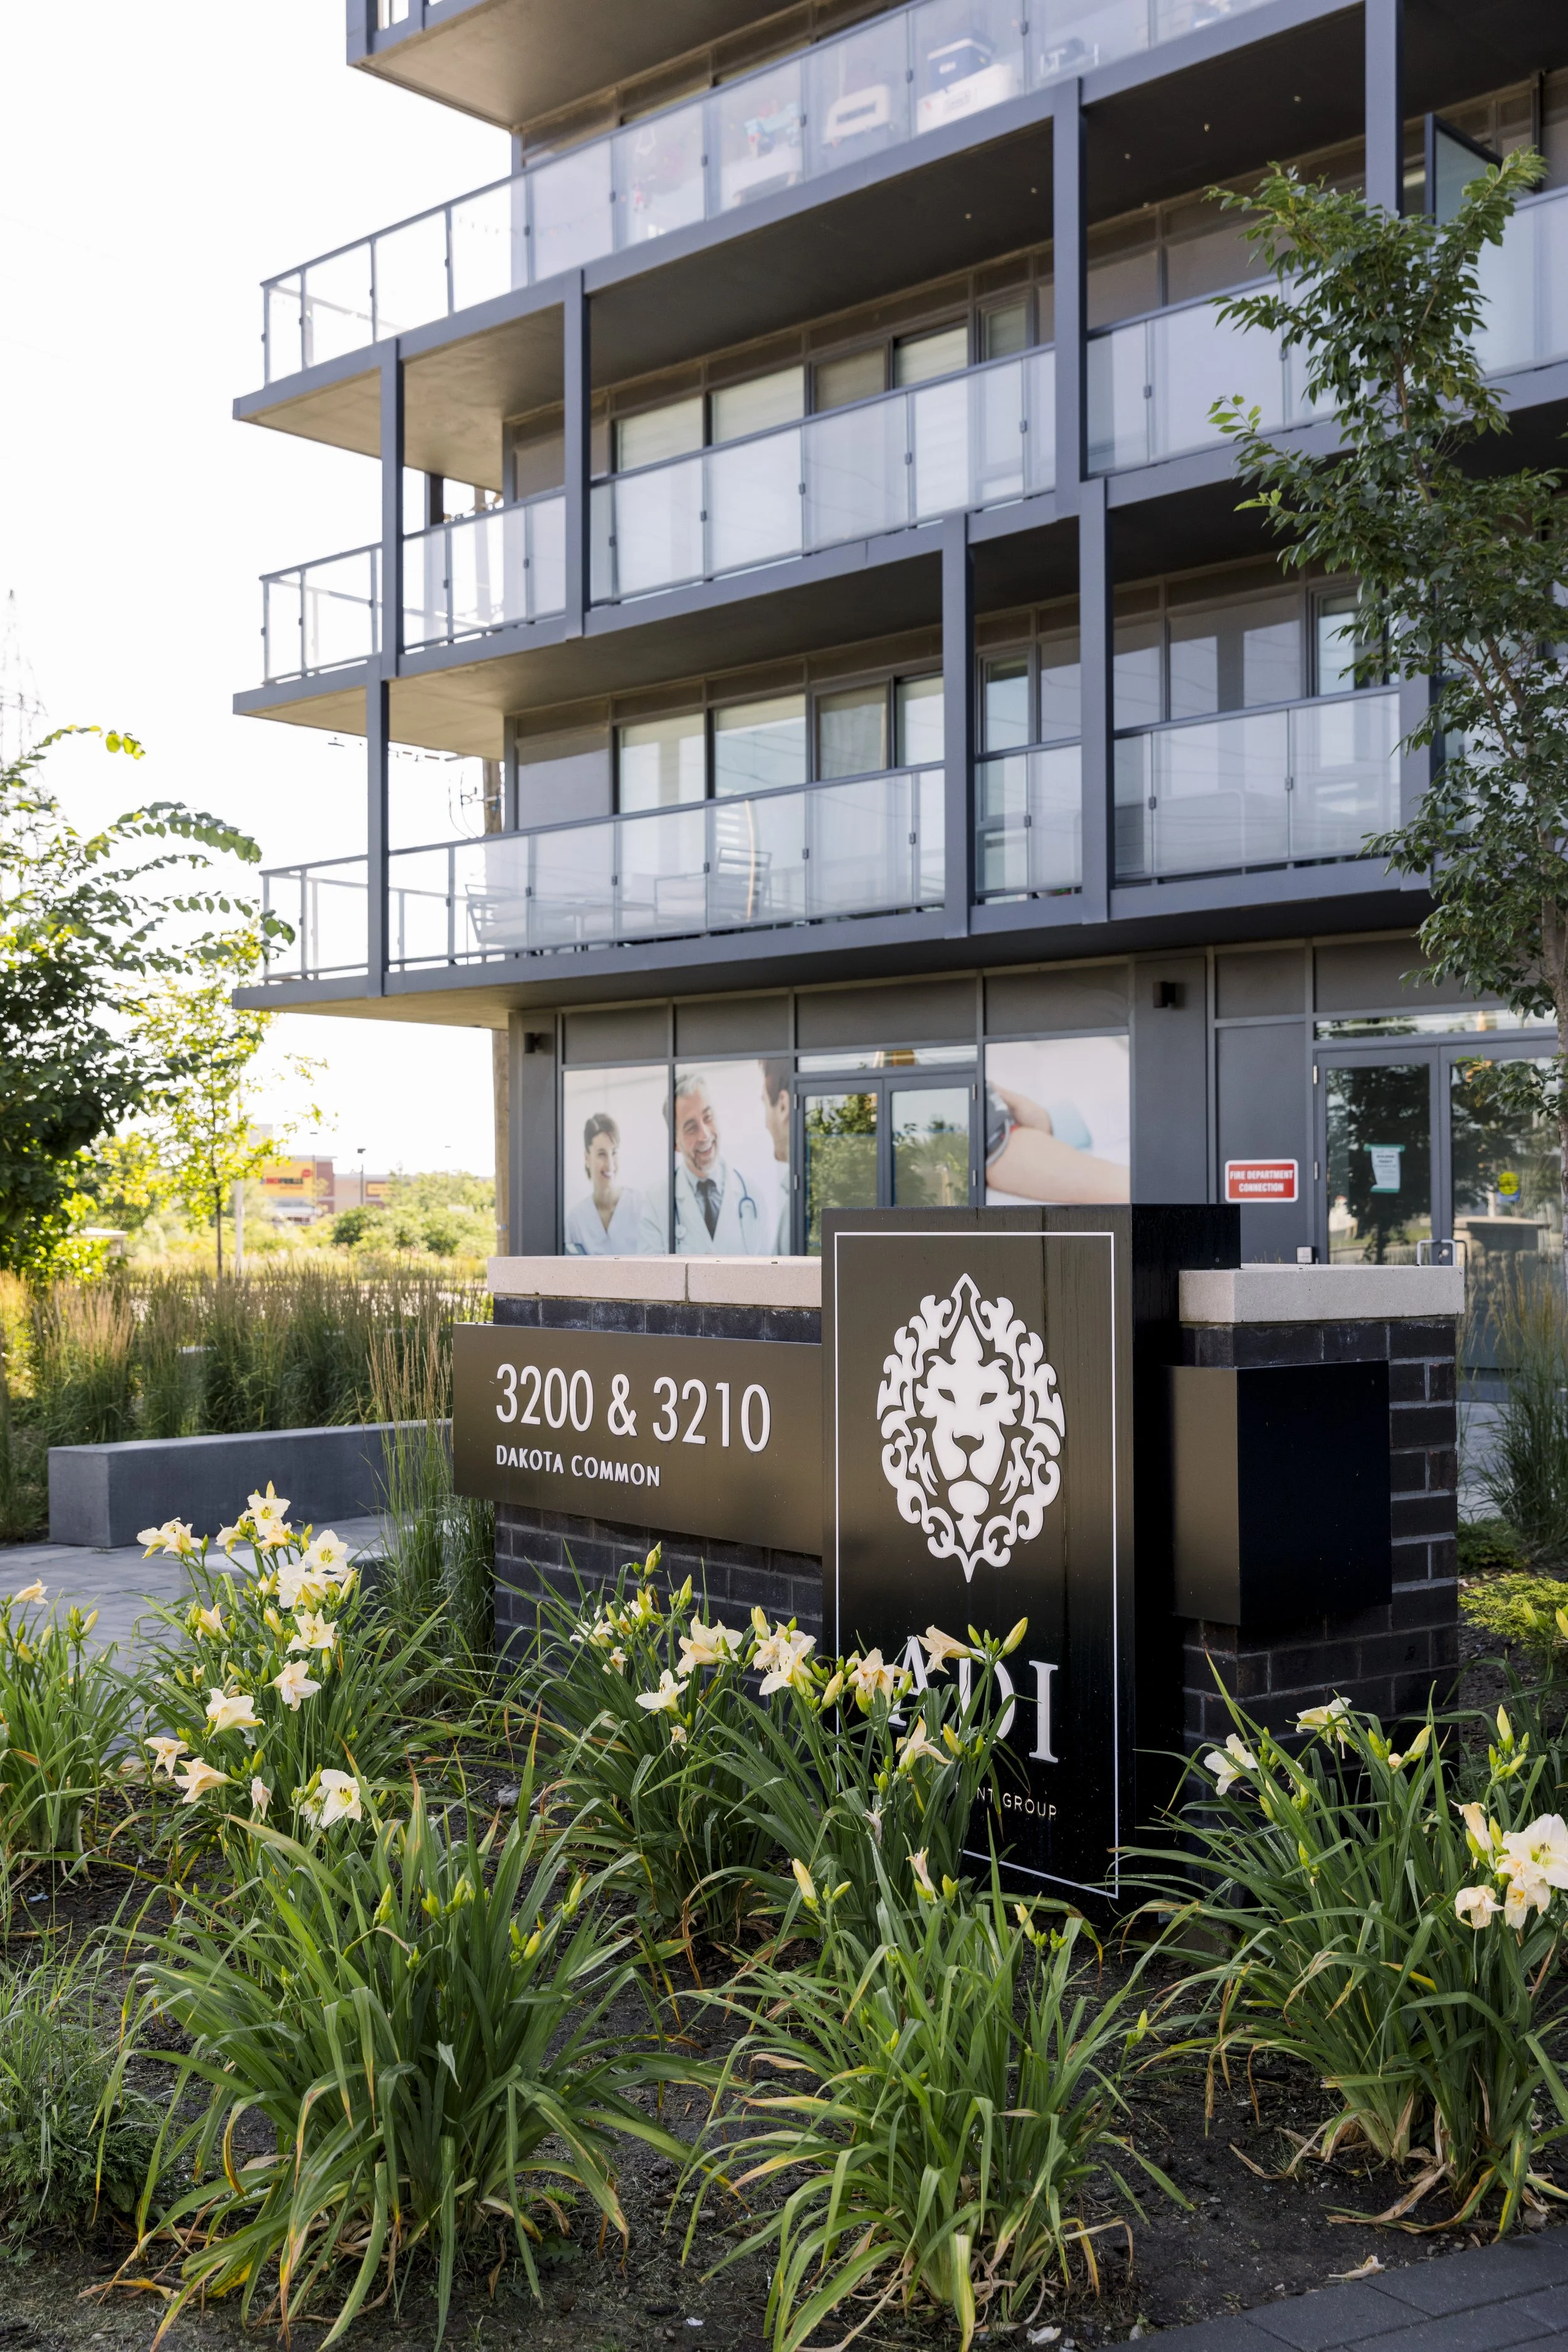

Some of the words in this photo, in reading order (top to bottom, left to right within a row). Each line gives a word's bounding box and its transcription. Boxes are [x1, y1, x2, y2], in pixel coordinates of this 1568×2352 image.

[1229, 1170, 1245, 1180] FIRE
[1246, 1169, 1293, 1180] DEPARTMENT
[1239, 1182, 1284, 1192] CONNECTION
[495, 1363, 594, 1433] 3200
[607, 1374, 637, 1437] &
[652, 1376, 771, 1453] 3210
[496, 1444, 564, 1475] DAKOTA
[571, 1454, 661, 1487] COMMON
[1003, 1792, 1057, 1819] GROUP
